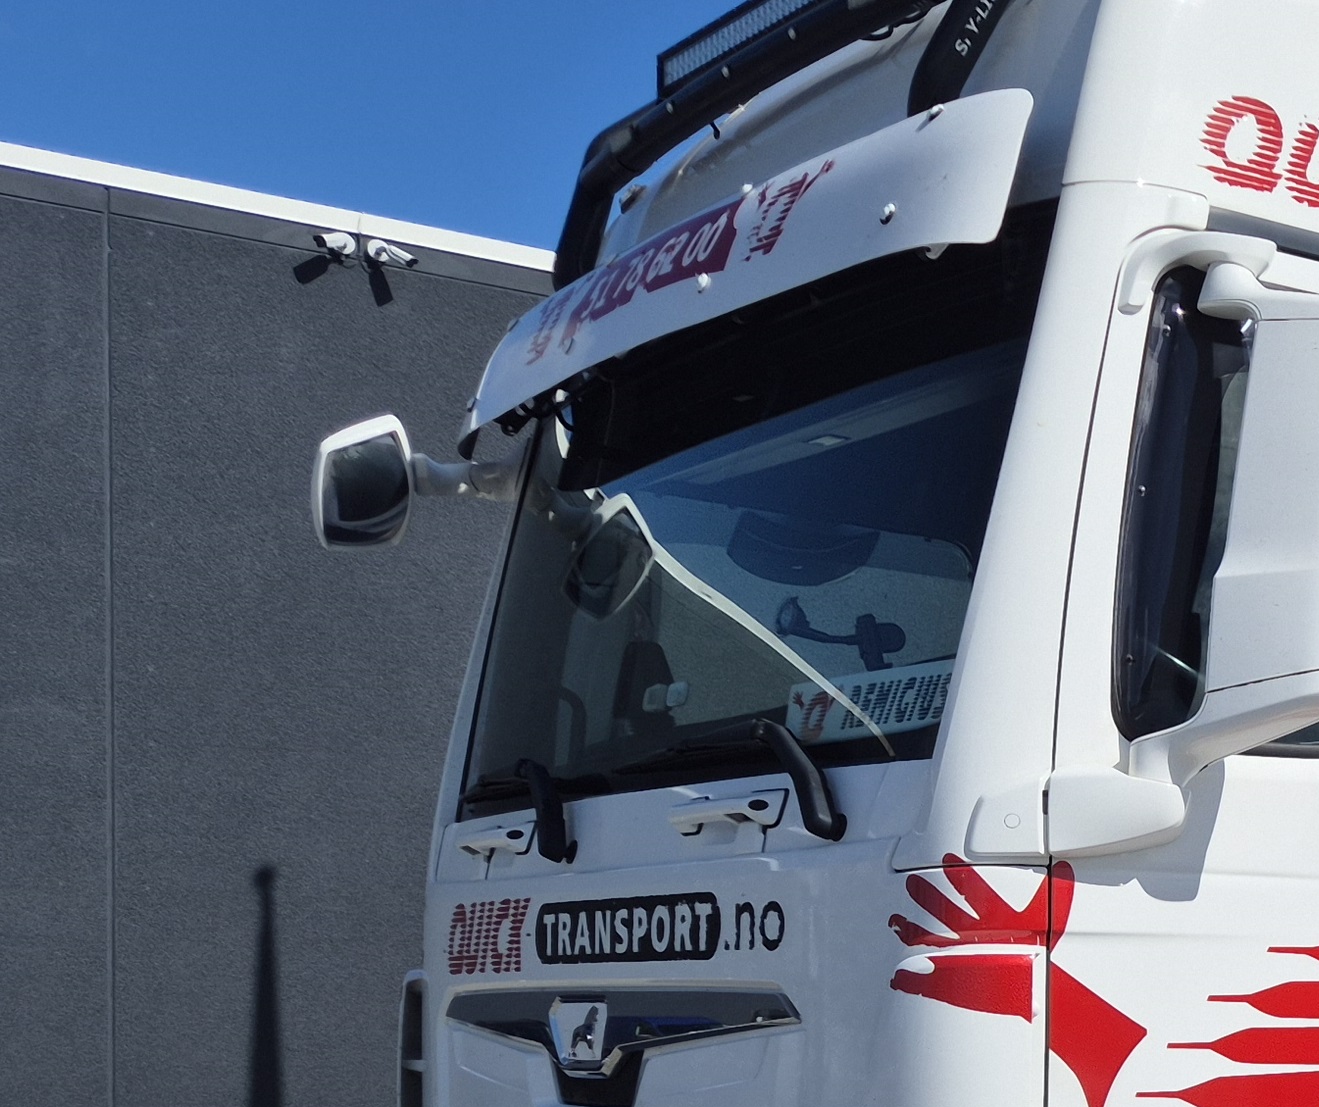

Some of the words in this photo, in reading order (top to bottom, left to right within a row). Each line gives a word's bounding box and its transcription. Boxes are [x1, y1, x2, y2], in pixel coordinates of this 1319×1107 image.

[682, 208, 730, 267] 00
[448, 897, 532, 976] QUICK
[542, 900, 716, 957] TRANSPORT
